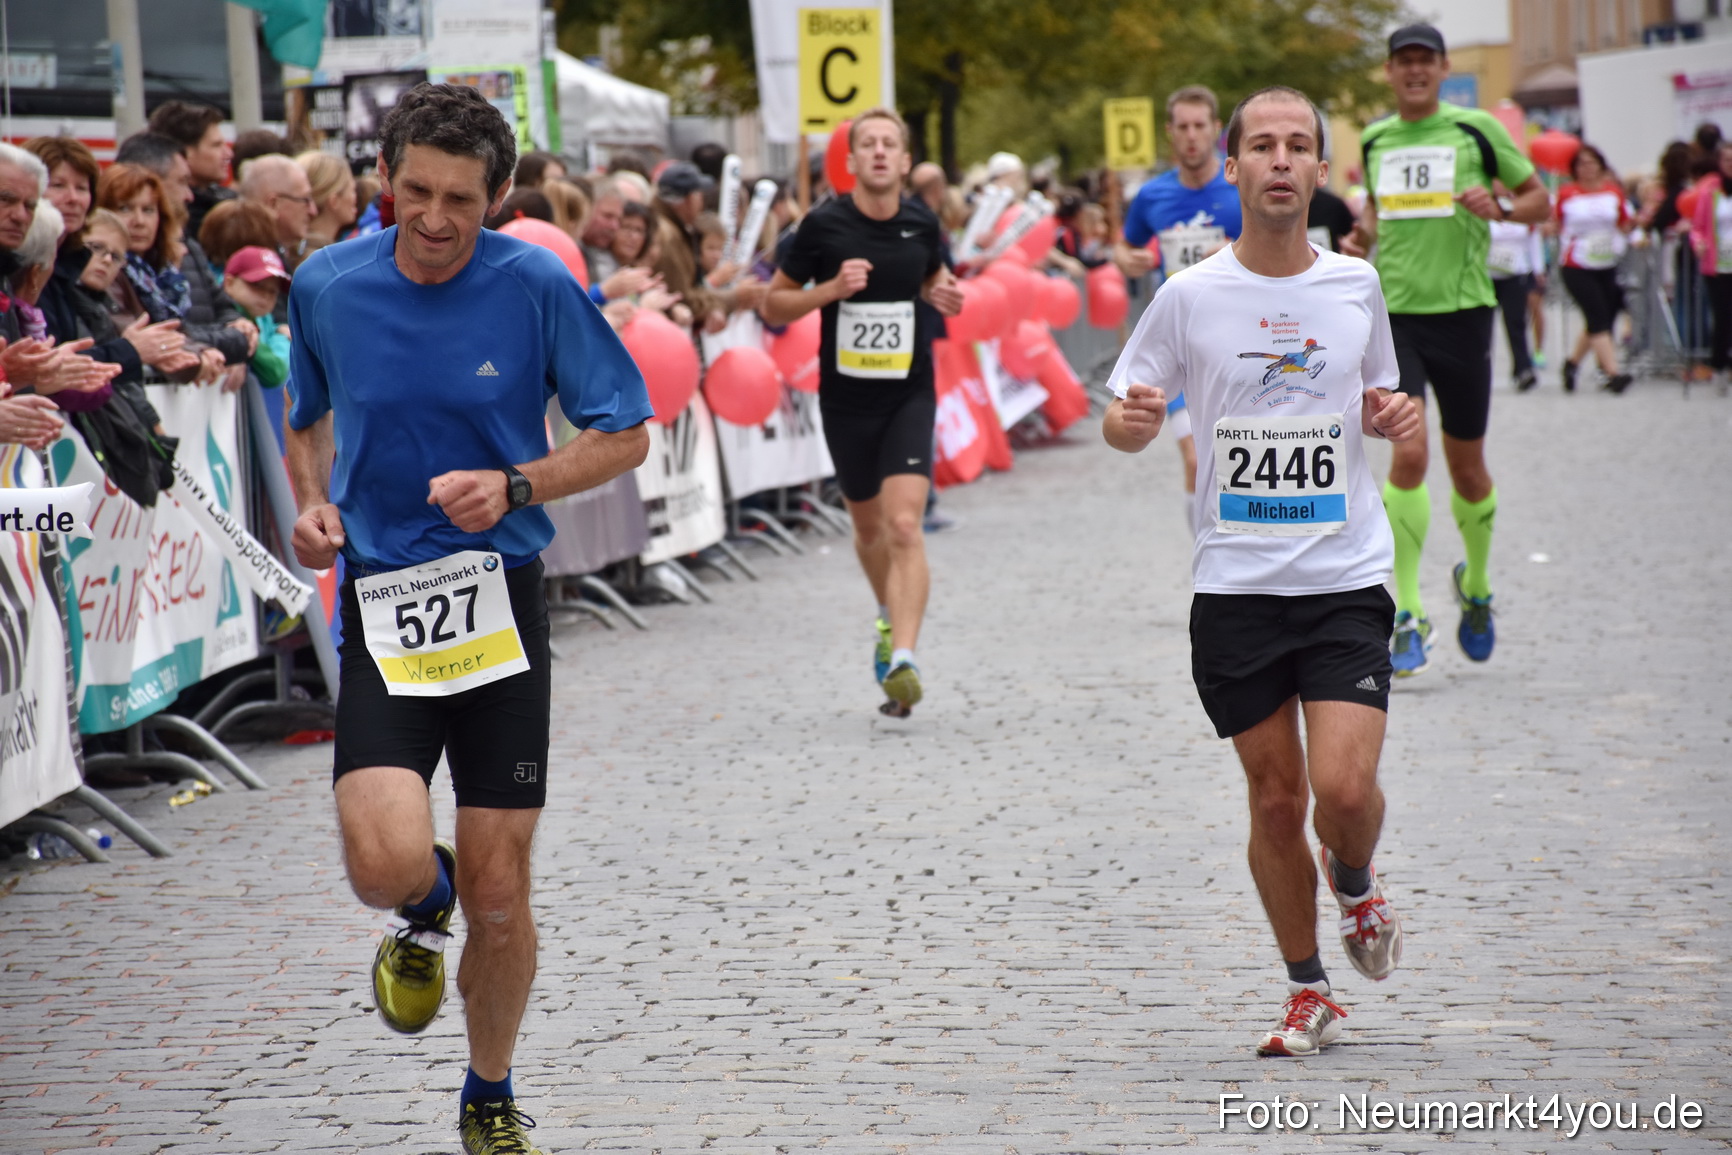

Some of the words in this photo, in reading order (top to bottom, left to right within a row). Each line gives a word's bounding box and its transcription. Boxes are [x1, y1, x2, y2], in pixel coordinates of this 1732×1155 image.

[808, 11, 874, 36] Block
[820, 46, 858, 105] C
[1119, 121, 1142, 154] D
[1403, 163, 1430, 190] 18
[853, 322, 902, 350] 223
[1216, 428, 1259, 440] PARTL
[1262, 428, 1325, 440] Neumarkt
[1229, 445, 1335, 490] 2446
[0, 504, 74, 532] rt.de
[1248, 501, 1315, 519] Michael
[361, 584, 409, 603] PARTL
[410, 564, 479, 592] Neumarkt
[395, 584, 479, 650] 527
[403, 653, 484, 681] Werner
